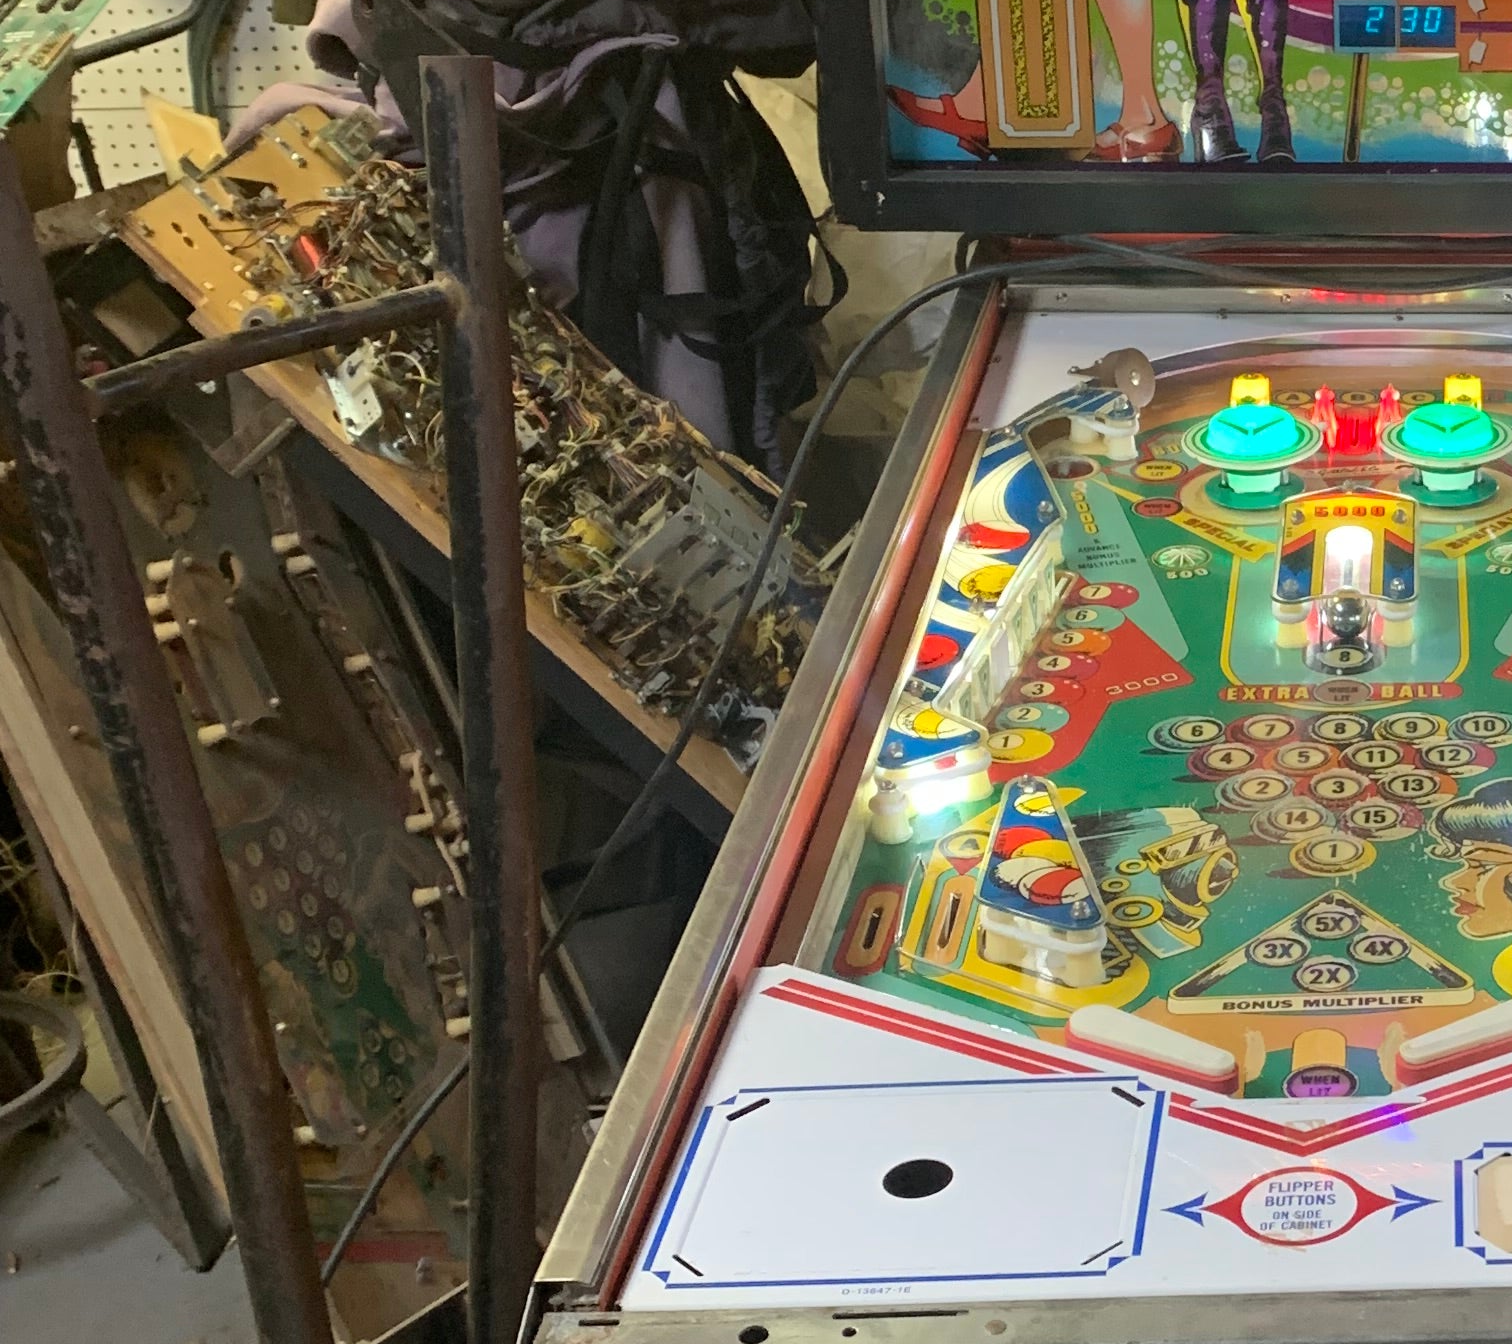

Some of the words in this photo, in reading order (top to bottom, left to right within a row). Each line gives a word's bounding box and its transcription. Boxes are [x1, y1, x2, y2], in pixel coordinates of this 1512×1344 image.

[1365, 6, 1384, 33] 2
[1400, 6, 1443, 34] 30
[1285, 393, 1300, 402] A
[1350, 393, 1366, 402] B
[1412, 394, 1426, 402] C
[1314, 506, 1386, 518] 5000
[1183, 517, 1260, 553] SPECIAL
[1078, 558, 1137, 569] MULTIPLIER
[1165, 568, 1209, 580] 500
[1090, 586, 1101, 597] 7
[1074, 610, 1088, 621] 6
[1061, 633, 1075, 645] 5
[1046, 657, 1059, 669] 4
[1339, 651, 1351, 662] 8
[1031, 683, 1045, 696] 3
[1104, 672, 1178, 696] 3000
[1226, 686, 1310, 701] EXTRA
[1381, 685, 1443, 698] BALL
[1017, 708, 1031, 721] 2
[1191, 725, 1204, 737] 6
[1265, 724, 1276, 736] 7
[1333, 722, 1346, 735] 8
[1405, 721, 1418, 734] 9
[1472, 719, 1496, 732] 10
[1001, 735, 1010, 748] 1
[1219, 752, 1233, 764] 4
[1297, 751, 1310, 763] 5
[1365, 750, 1387, 763] 11
[1436, 748, 1461, 762] 12
[1256, 781, 1270, 795] 2
[1332, 780, 1345, 794] 3
[1400, 778, 1425, 792] 13
[1285, 811, 1309, 825] 14
[1362, 810, 1386, 824] 15
[960, 838, 980, 851] A
[1328, 844, 1337, 857] 1
[1315, 916, 1344, 932] 5X
[1263, 943, 1294, 959] 3X
[1363, 940, 1396, 956] 4X
[1309, 968, 1341, 985] 2X
[1222, 999, 1293, 1011] BONUS
[1302, 995, 1424, 1009] MULTIPLIER
[1300, 1074, 1341, 1085] WHEN
[1308, 1087, 1331, 1097] LIT
[1268, 1180, 1335, 1194] FLIPPER
[1265, 1194, 1337, 1207] BUTTONS
[1272, 1210, 1289, 1220] ON
[1294, 1209, 1322, 1219] SIDE
[1259, 1222, 1276, 1231] OF
[1281, 1219, 1333, 1231] CABINET
